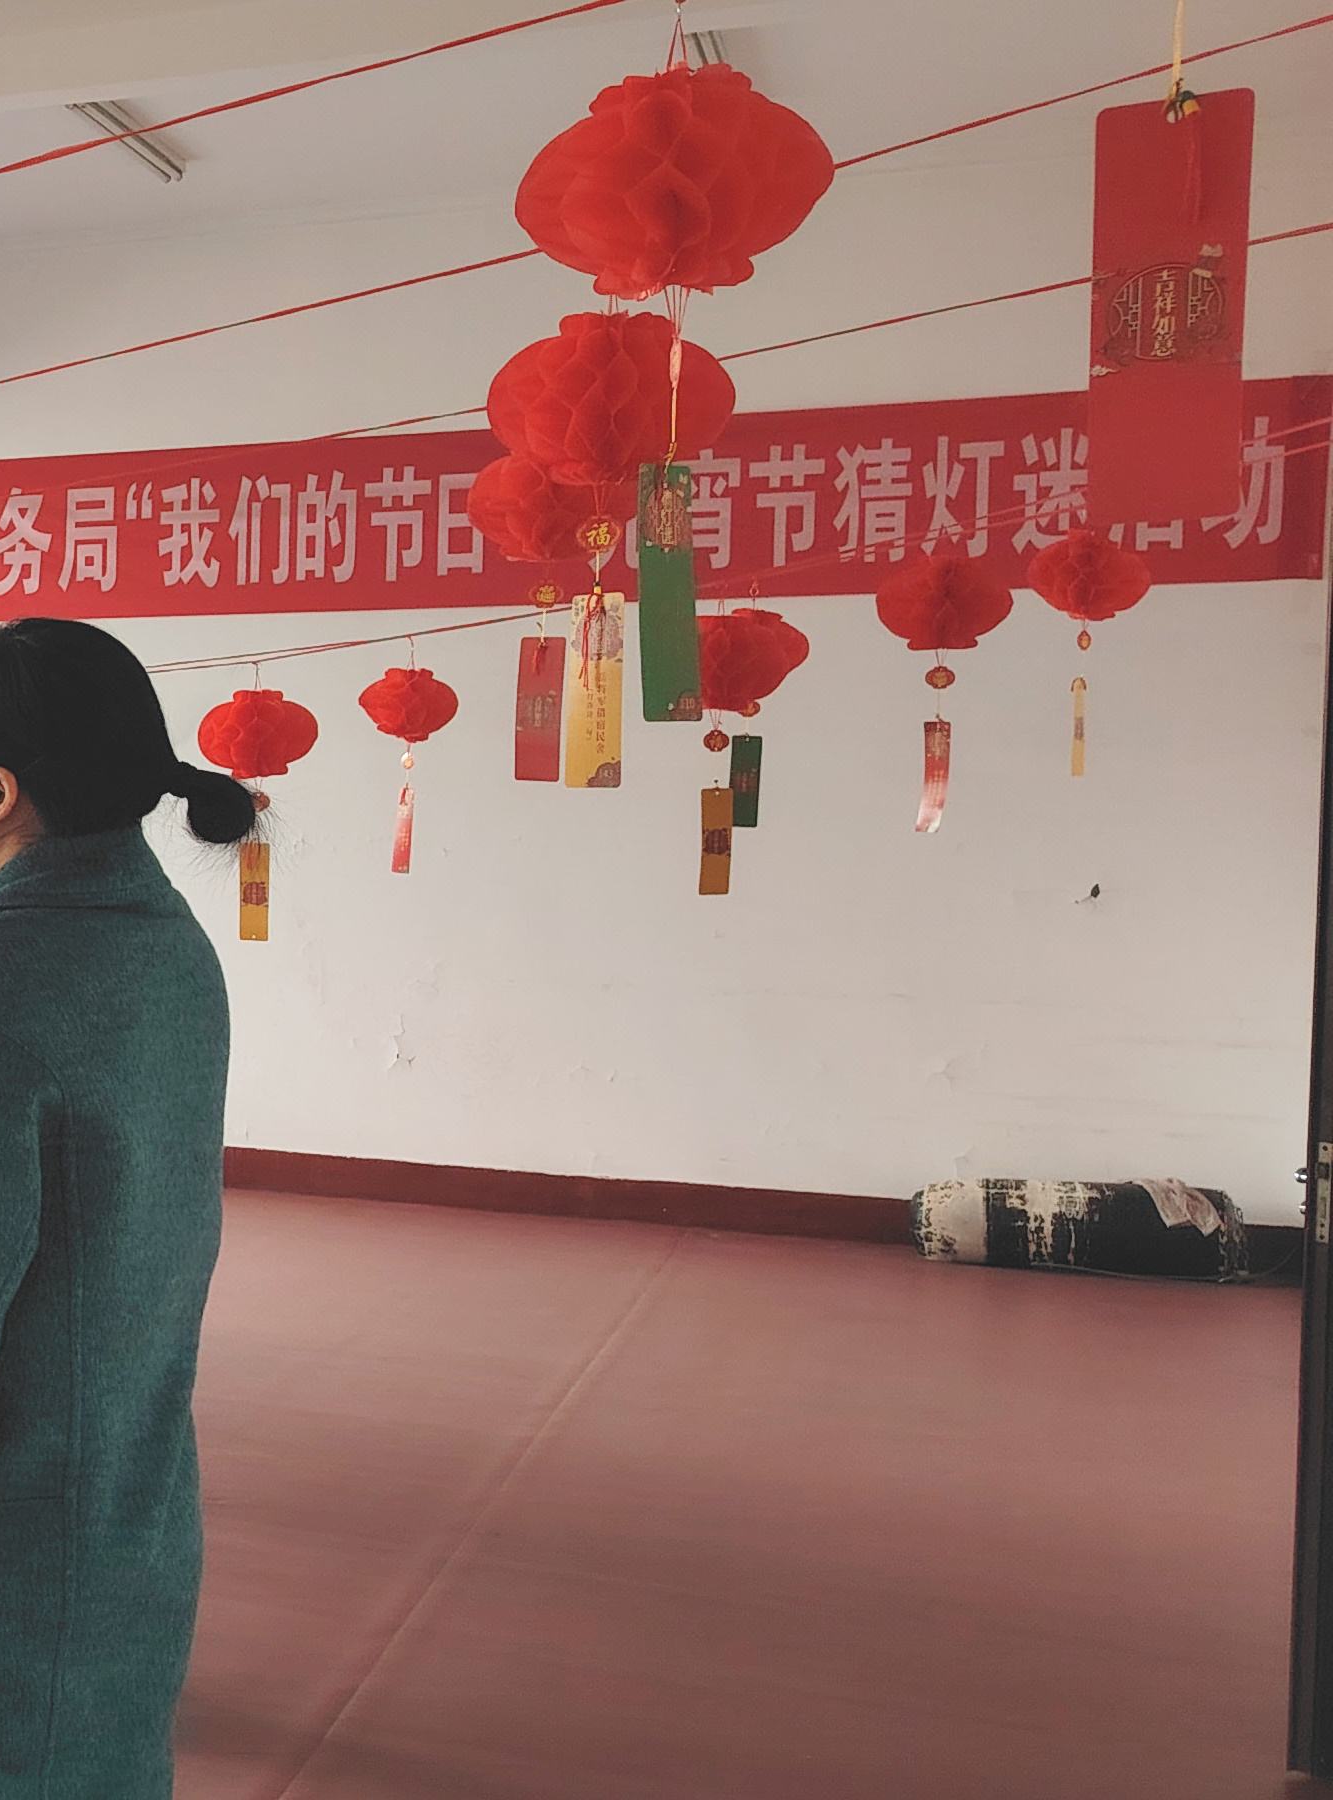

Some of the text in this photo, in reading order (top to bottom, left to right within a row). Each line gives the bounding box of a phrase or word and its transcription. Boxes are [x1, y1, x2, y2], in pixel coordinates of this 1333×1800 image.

[1149, 269, 1178, 358] 吉祥如意
[586, 523, 611, 547] 福
